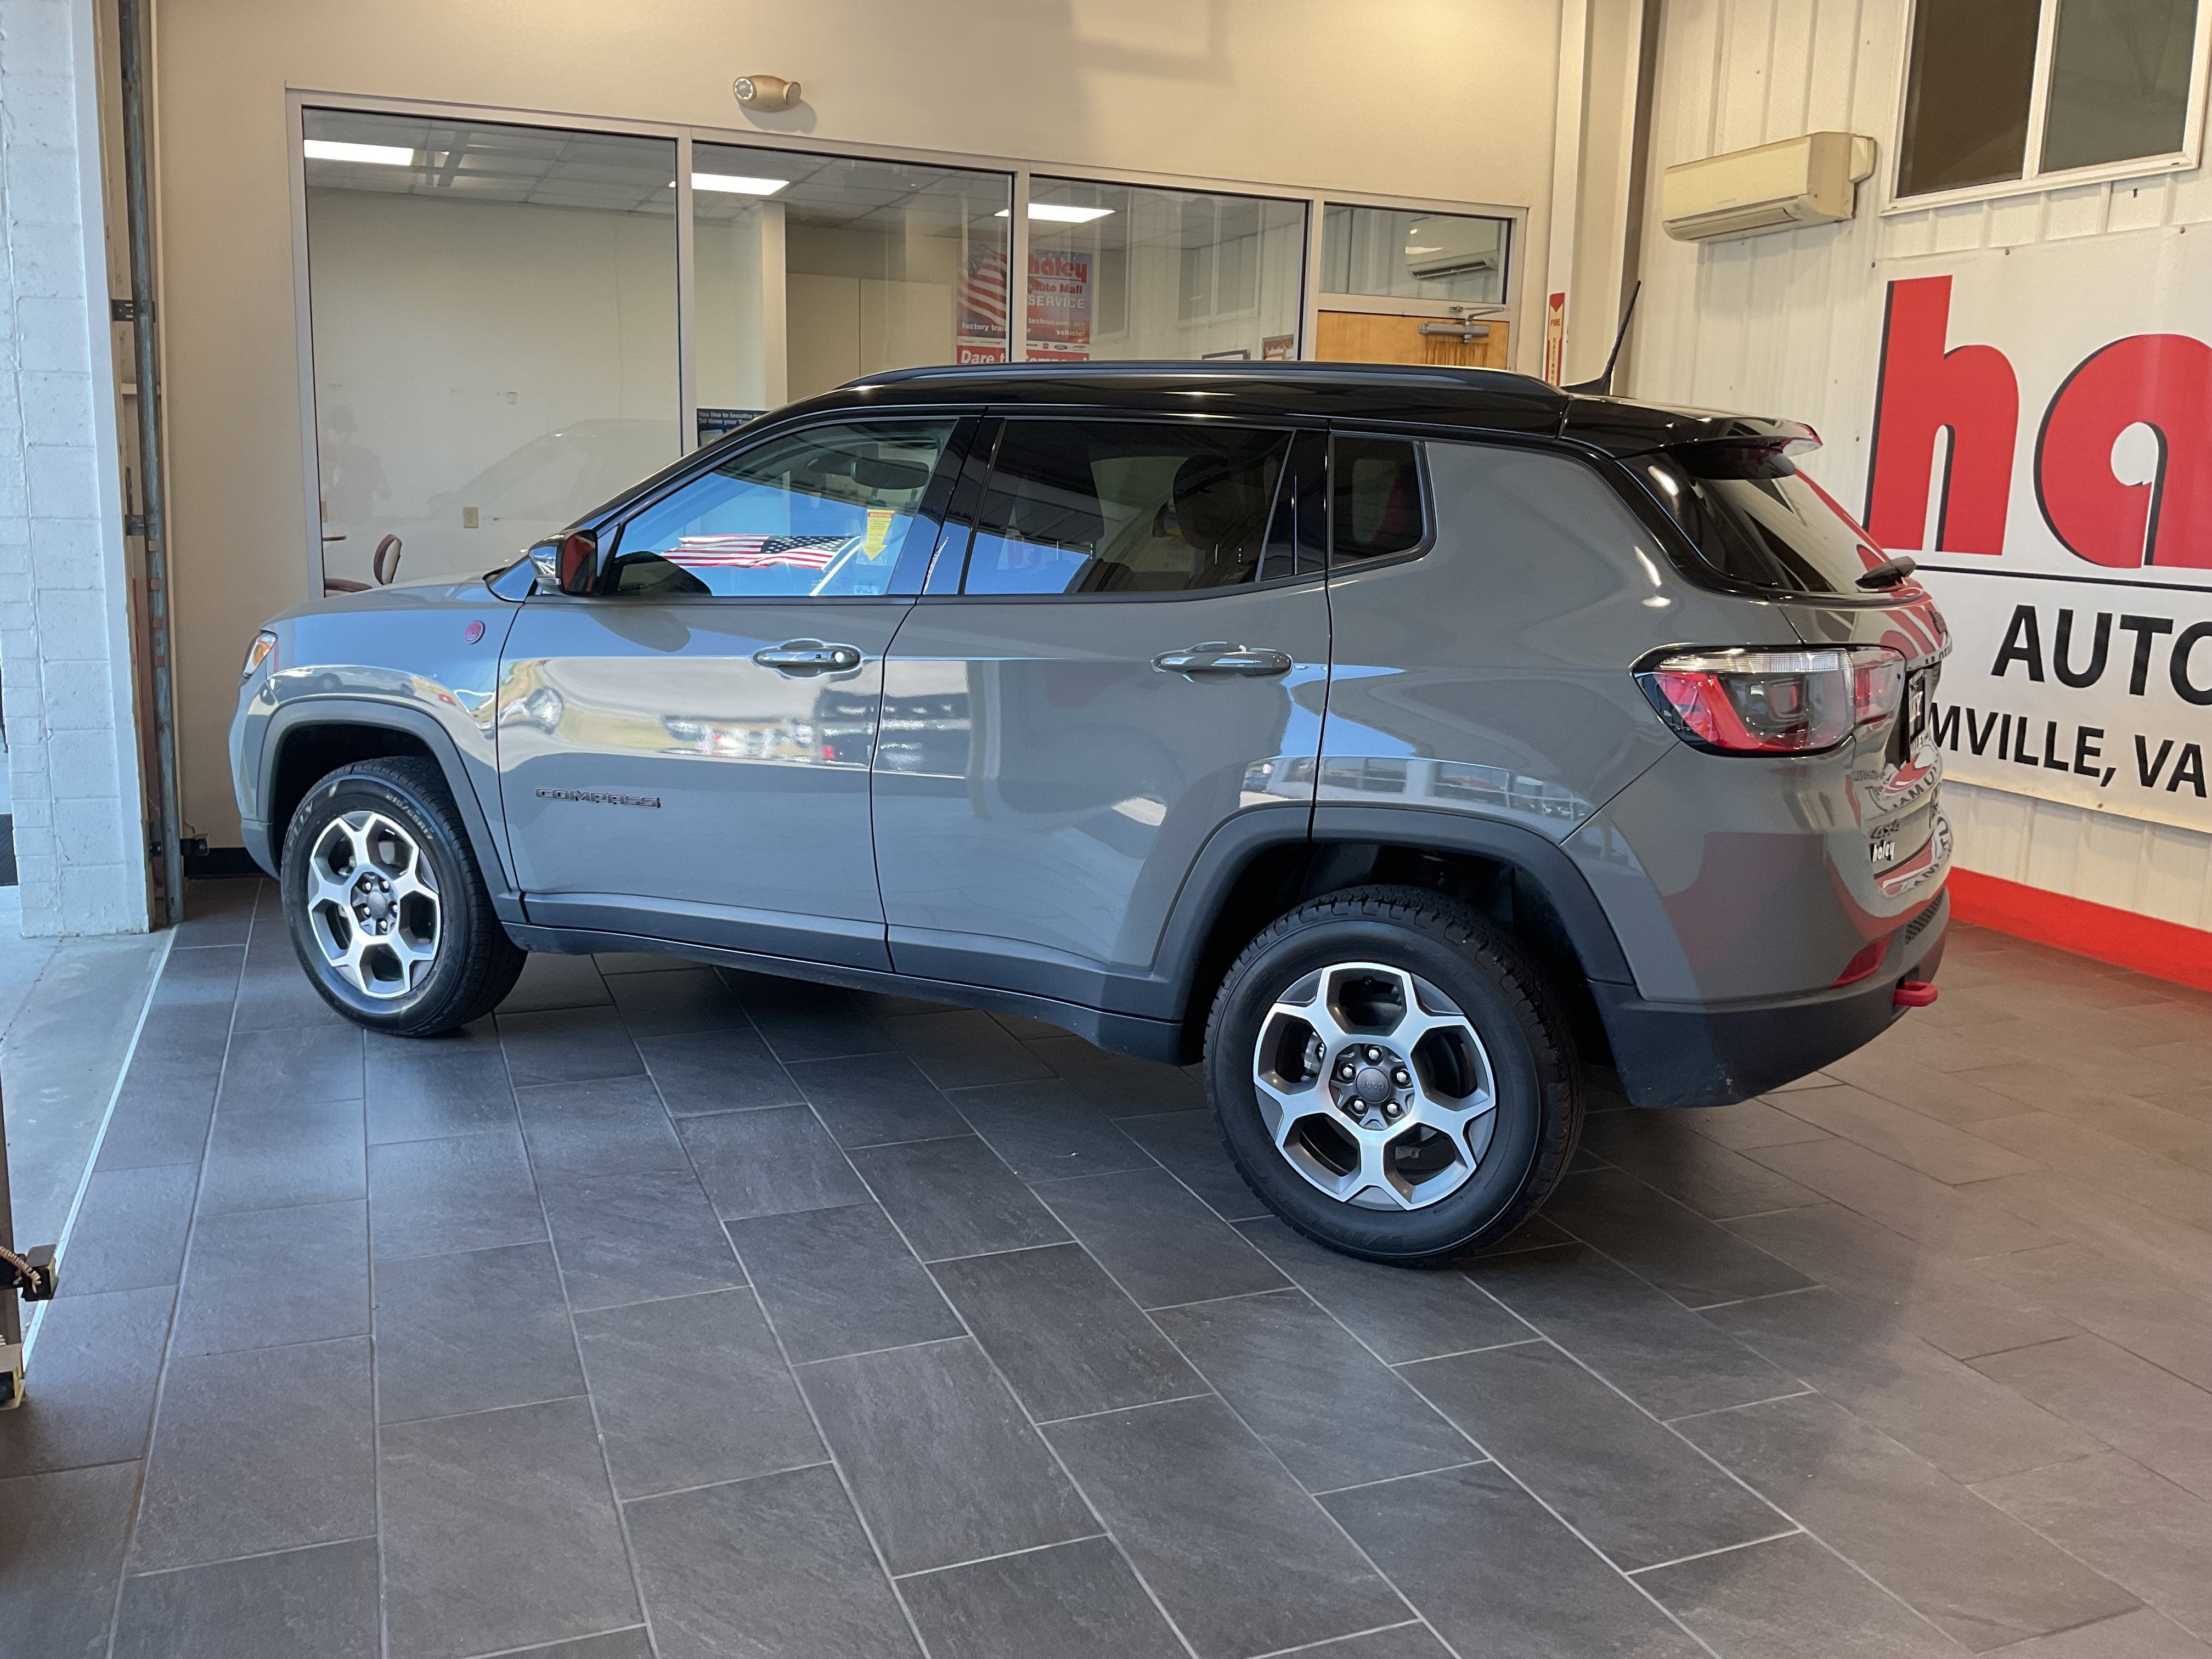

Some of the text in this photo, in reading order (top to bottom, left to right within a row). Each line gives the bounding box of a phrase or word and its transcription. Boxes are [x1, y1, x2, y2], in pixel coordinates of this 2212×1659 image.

[1028, 254, 1087, 284] haley
[1060, 284, 1082, 294] Mall
[1028, 294, 1085, 308] SERVICE
[962, 322, 989, 331] factory
[1028, 317, 1070, 326] technicians
[961, 350, 1006, 364] Dare t
[2134, 734, 2207, 798] VA
[535, 788, 661, 809] COMPASS
[1871, 840, 1895, 862] haley
[1360, 1079, 1386, 1091] Jeep
